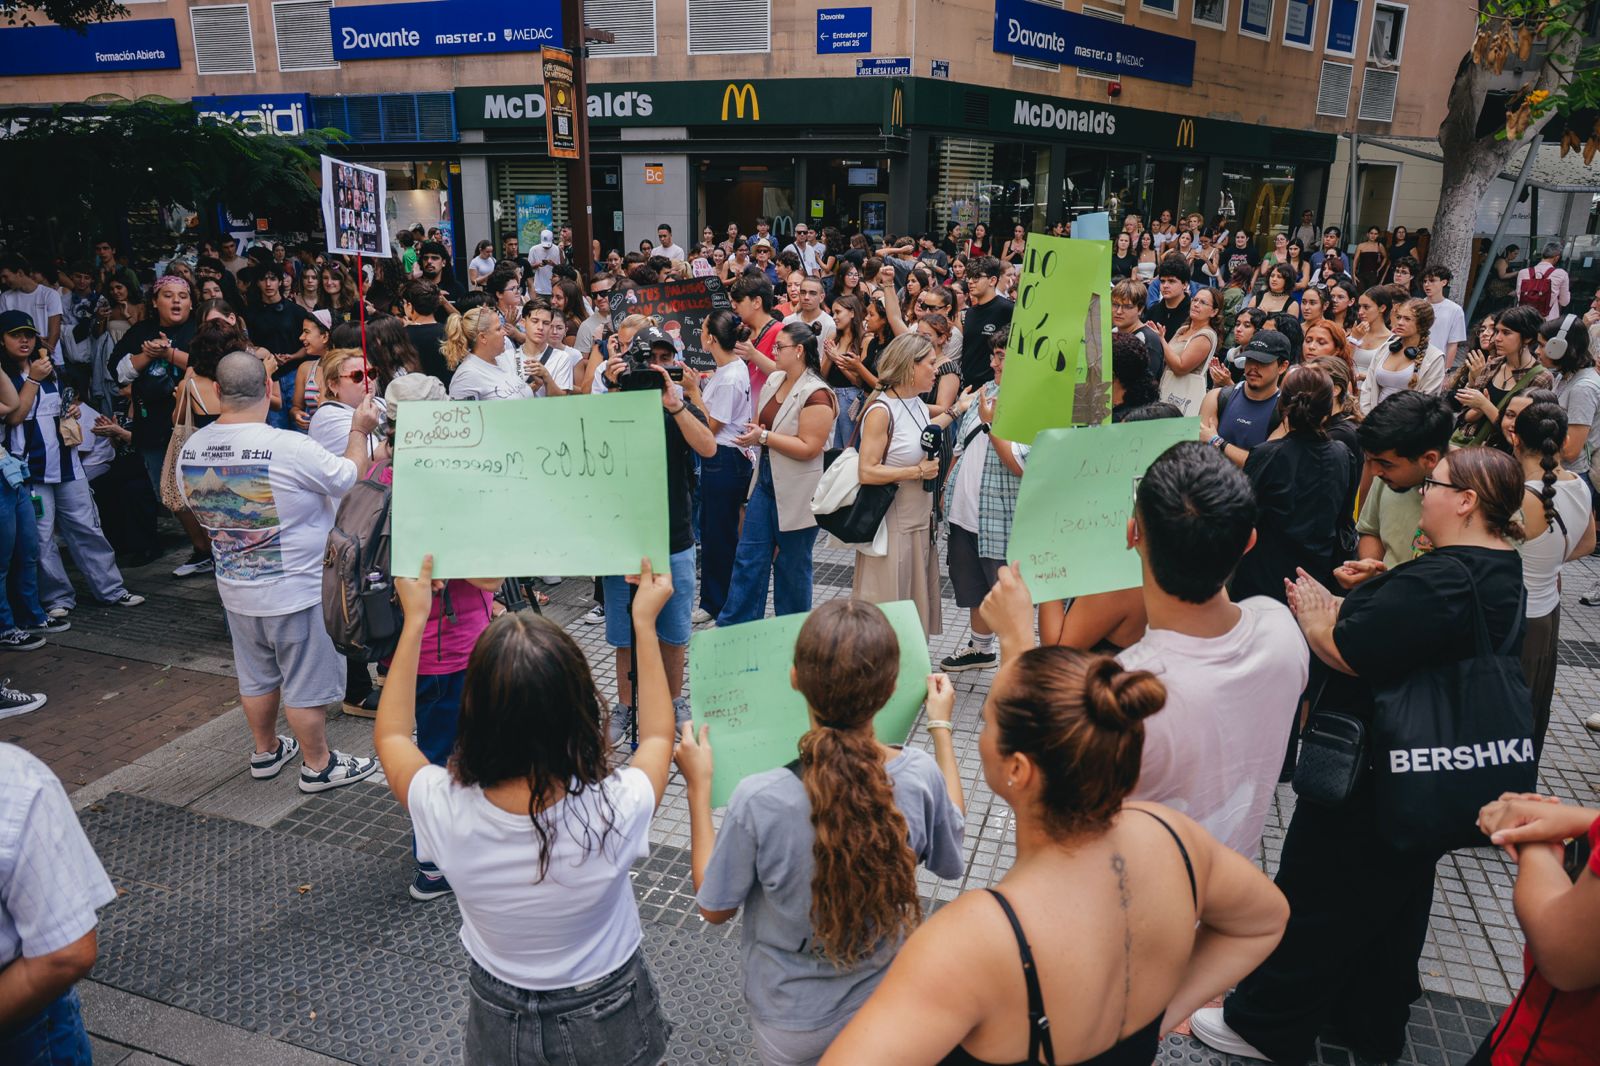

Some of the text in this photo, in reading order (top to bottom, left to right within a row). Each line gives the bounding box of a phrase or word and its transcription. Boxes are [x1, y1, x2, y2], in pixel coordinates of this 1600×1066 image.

[820, 13, 845, 21] Davante
[341, 27, 420, 50] Davante
[512, 27, 553, 41] MEDAC
[832, 31, 868, 40] Entrada por
[832, 39, 860, 49] portal 25
[1007, 18, 1066, 53] Davante
[1120, 54, 1145, 68] MEDAC
[95, 49, 166, 62] Formación Abierta
[858, 67, 872, 76] JOSE
[872, 66, 886, 75] MESA
[891, 66, 909, 75] LOPEZ
[484, 91, 653, 119] McDald's
[1013, 99, 1116, 135] McDonald's
[646, 169, 662, 182] Bc
[637, 287, 660, 303] TUS
[241, 449, 273, 460] 富士山
[1389, 738, 1535, 773] BERSHKA
